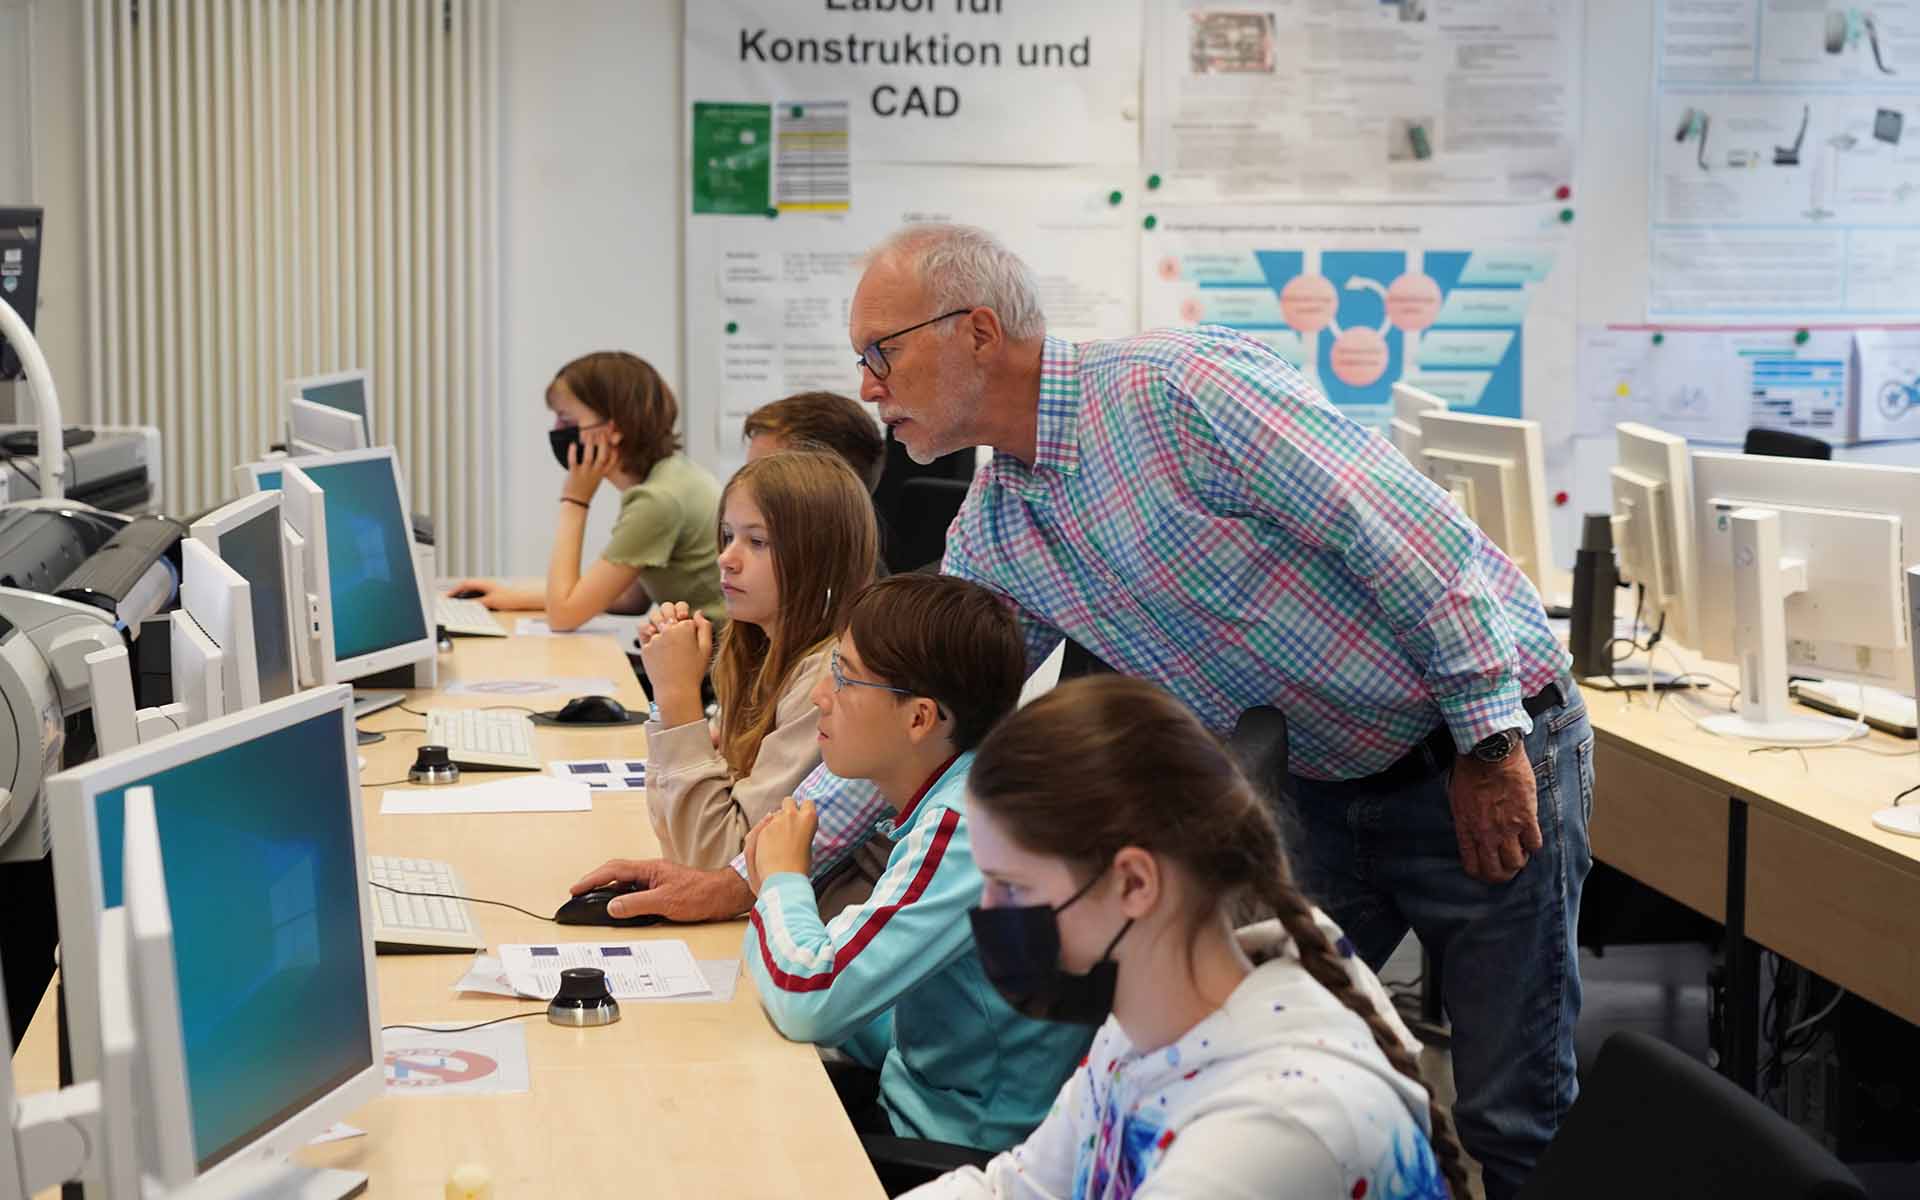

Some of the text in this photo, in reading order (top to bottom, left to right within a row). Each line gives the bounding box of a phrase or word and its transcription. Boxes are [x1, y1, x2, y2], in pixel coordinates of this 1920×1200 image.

[738, 28, 1091, 67] Konstruktion und
[870, 84, 960, 118] CAD
